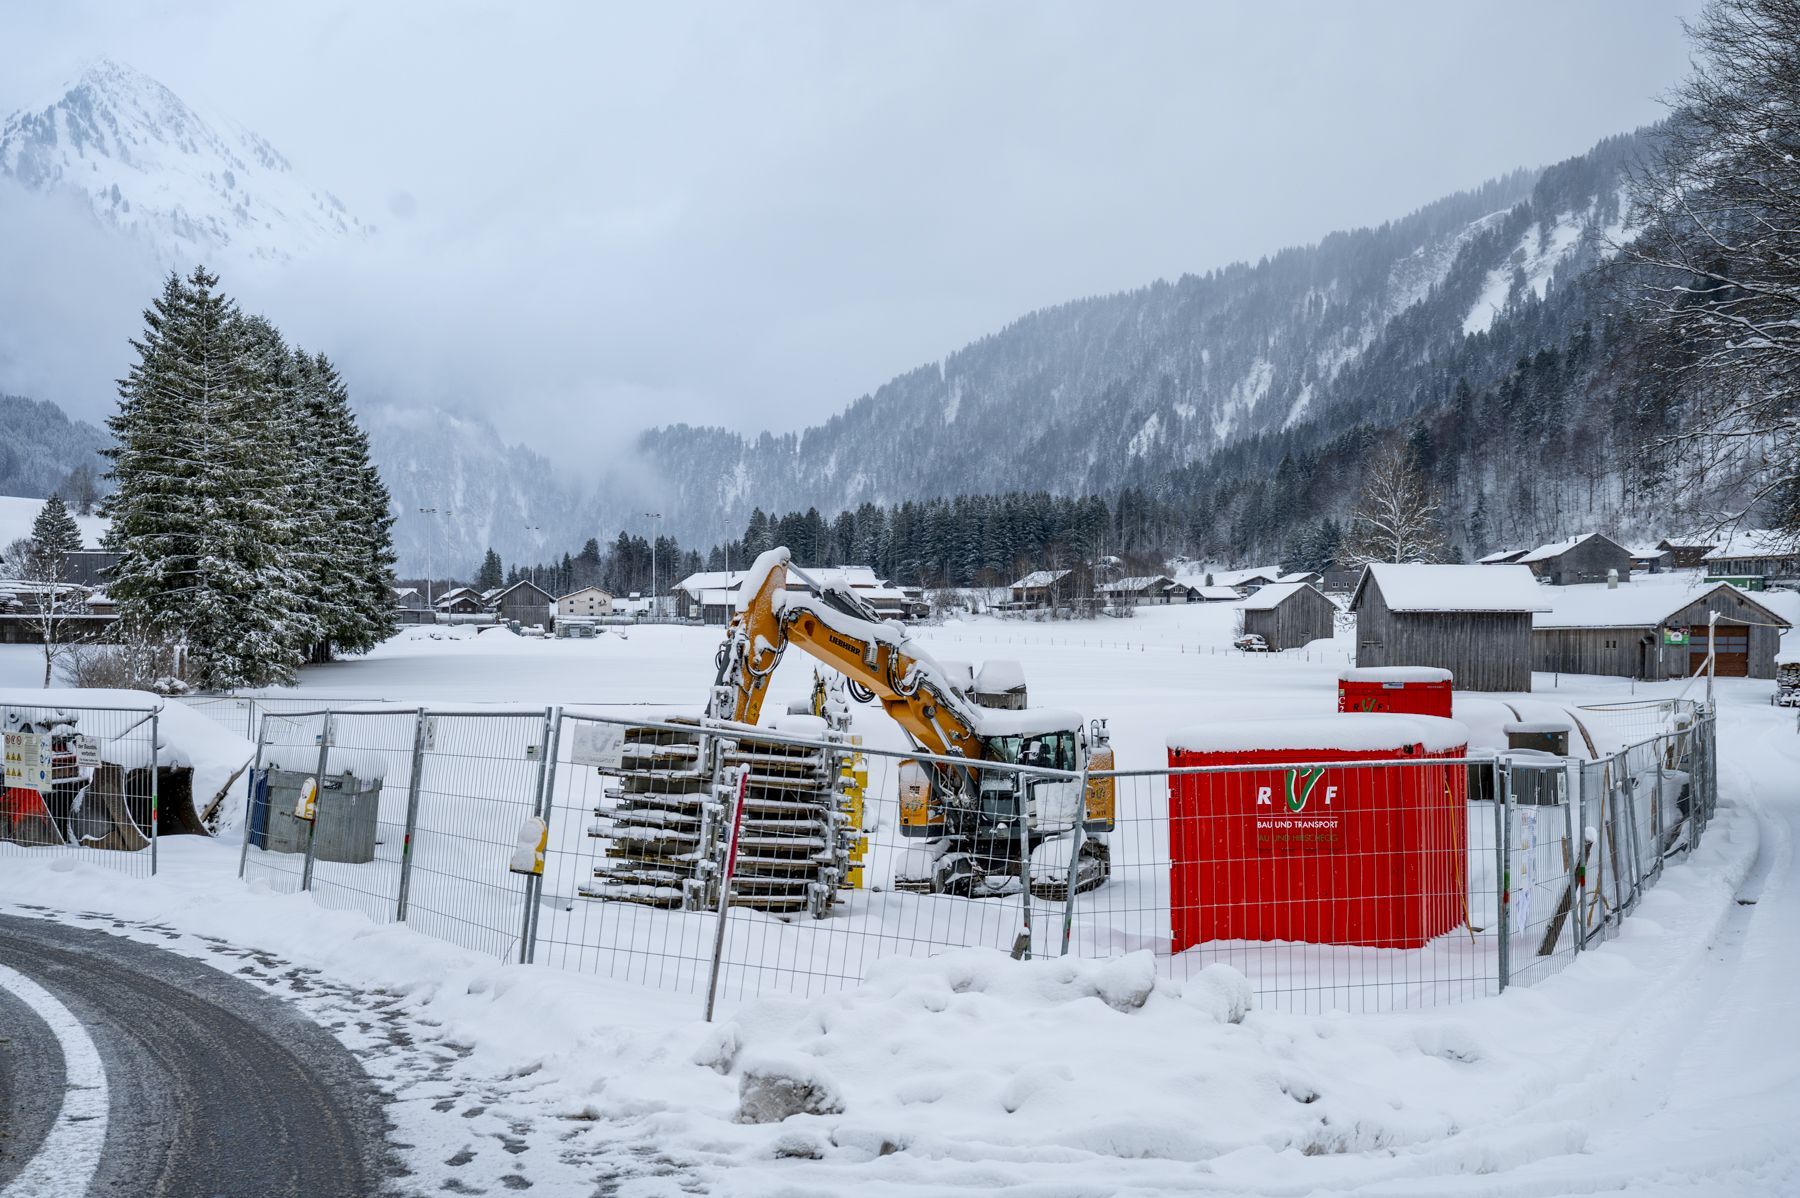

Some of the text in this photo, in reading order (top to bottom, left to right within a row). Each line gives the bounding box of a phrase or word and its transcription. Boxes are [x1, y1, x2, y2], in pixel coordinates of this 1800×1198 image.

[829, 635, 860, 656] LIEBHERR
[1257, 821, 1338, 829] BAU UND TRANSPORT
